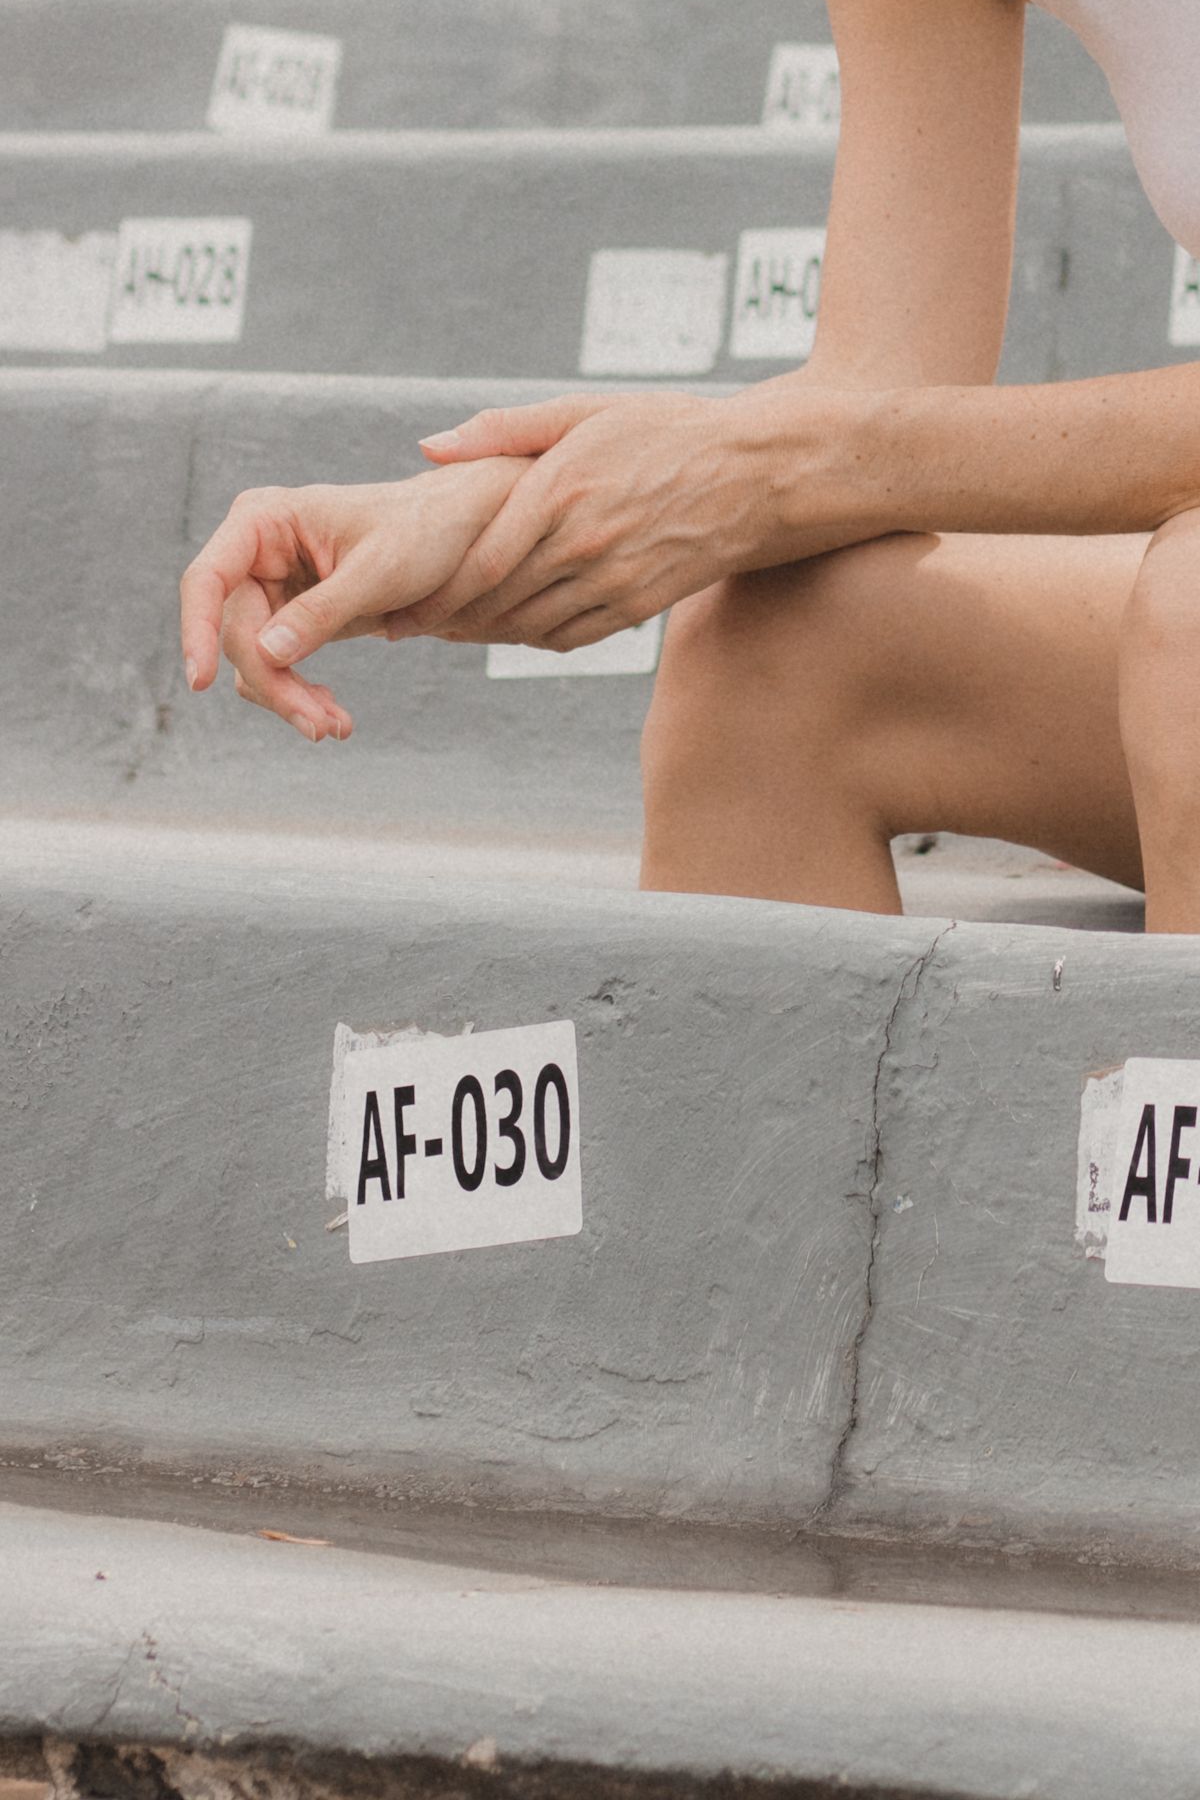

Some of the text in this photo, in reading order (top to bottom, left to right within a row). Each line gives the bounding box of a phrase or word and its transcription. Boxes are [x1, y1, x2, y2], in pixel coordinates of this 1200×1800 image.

[119, 245, 238, 305] AH-028
[742, 256, 820, 319] AH-0
[357, 1062, 571, 1205] AF-030
